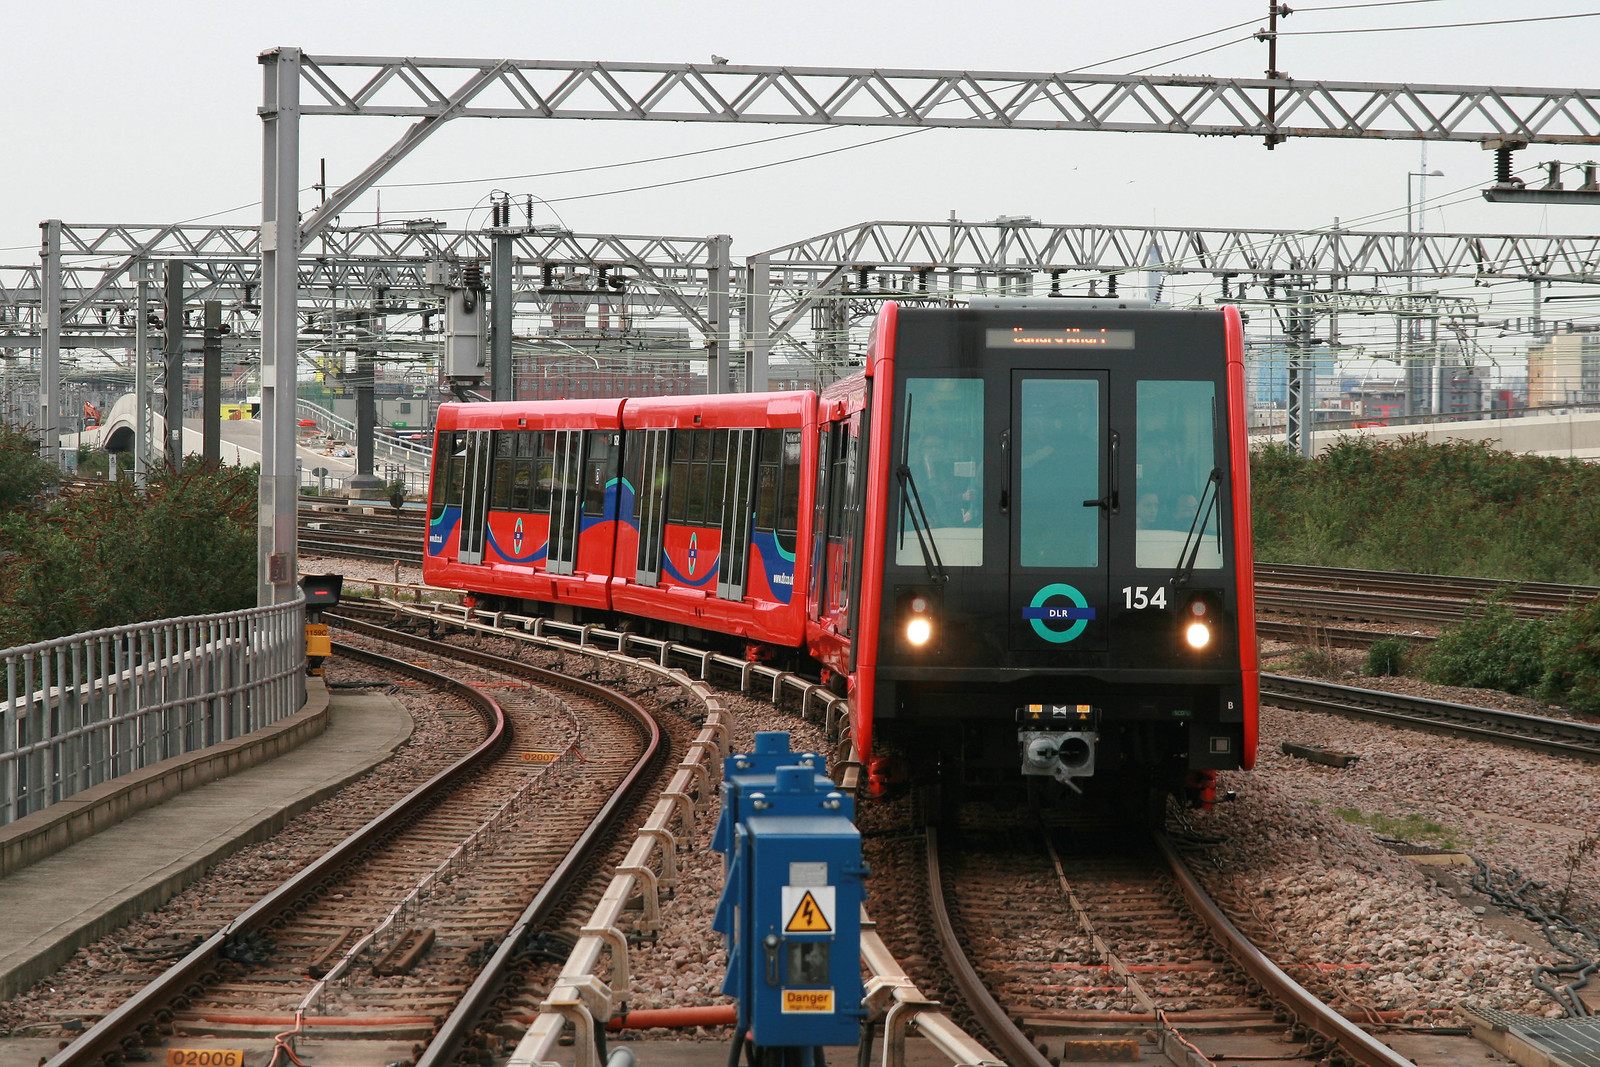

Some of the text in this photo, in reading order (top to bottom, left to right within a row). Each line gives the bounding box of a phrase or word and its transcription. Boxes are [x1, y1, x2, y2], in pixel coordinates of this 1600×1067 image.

[1122, 586, 1167, 609] 154
[1049, 609, 1068, 618] DLR
[1227, 701, 1234, 710] B
[524, 753, 556, 761] 02007
[787, 992, 829, 1004] Danger
[173, 1051, 236, 1066] 02006
